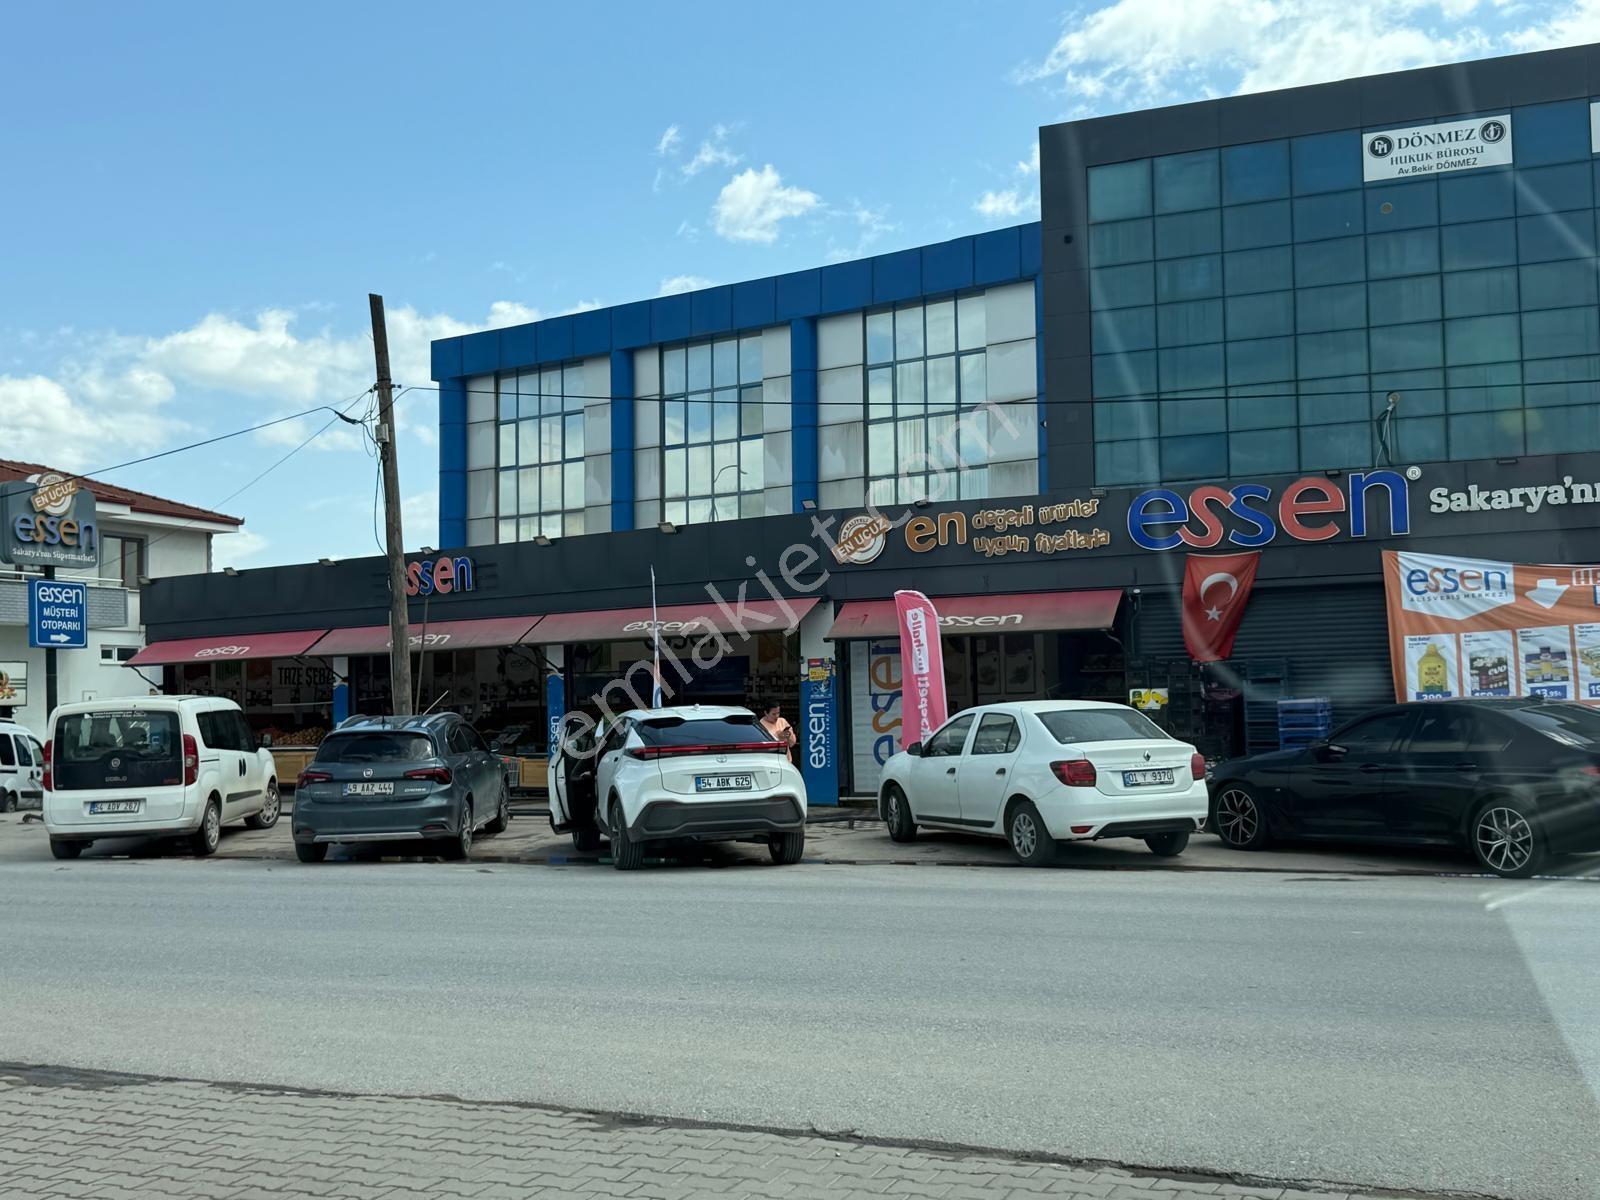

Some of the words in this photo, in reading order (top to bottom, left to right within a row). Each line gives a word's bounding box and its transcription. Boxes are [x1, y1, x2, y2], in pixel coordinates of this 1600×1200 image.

[1397, 128, 1476, 150] DÖNMEZ
[1390, 152, 1432, 166] HUKUK
[1436, 145, 1484, 160] BÜROSU
[1436, 157, 1478, 170] DÖNMEZ
[35, 494, 48, 507] EN
[49, 481, 75, 502] UCUZ
[972, 505, 1034, 532] değerli
[1039, 499, 1099, 525] ürünler
[15, 513, 97, 548] essen
[837, 541, 855, 557] EN
[855, 518, 887, 545] UCUZ
[905, 512, 967, 553] en
[973, 535, 1030, 557] uygun
[403, 556, 473, 596] ssen
[1406, 567, 1508, 596] essen
[38, 586, 83, 605] essen
[43, 605, 79, 619] MÜŞTERİ
[41, 620, 81, 631] OTOPARKI
[194, 645, 250, 658] essen
[809, 702, 826, 769] essen
[361, 783, 375, 793] AAZ
[702, 778, 711, 788] 54
[716, 777, 731, 787] ABK
[735, 776, 750, 786] 625
[1129, 772, 1138, 783] 01
[1141, 772, 1147, 782] Y
[1151, 771, 1172, 781] 9370
